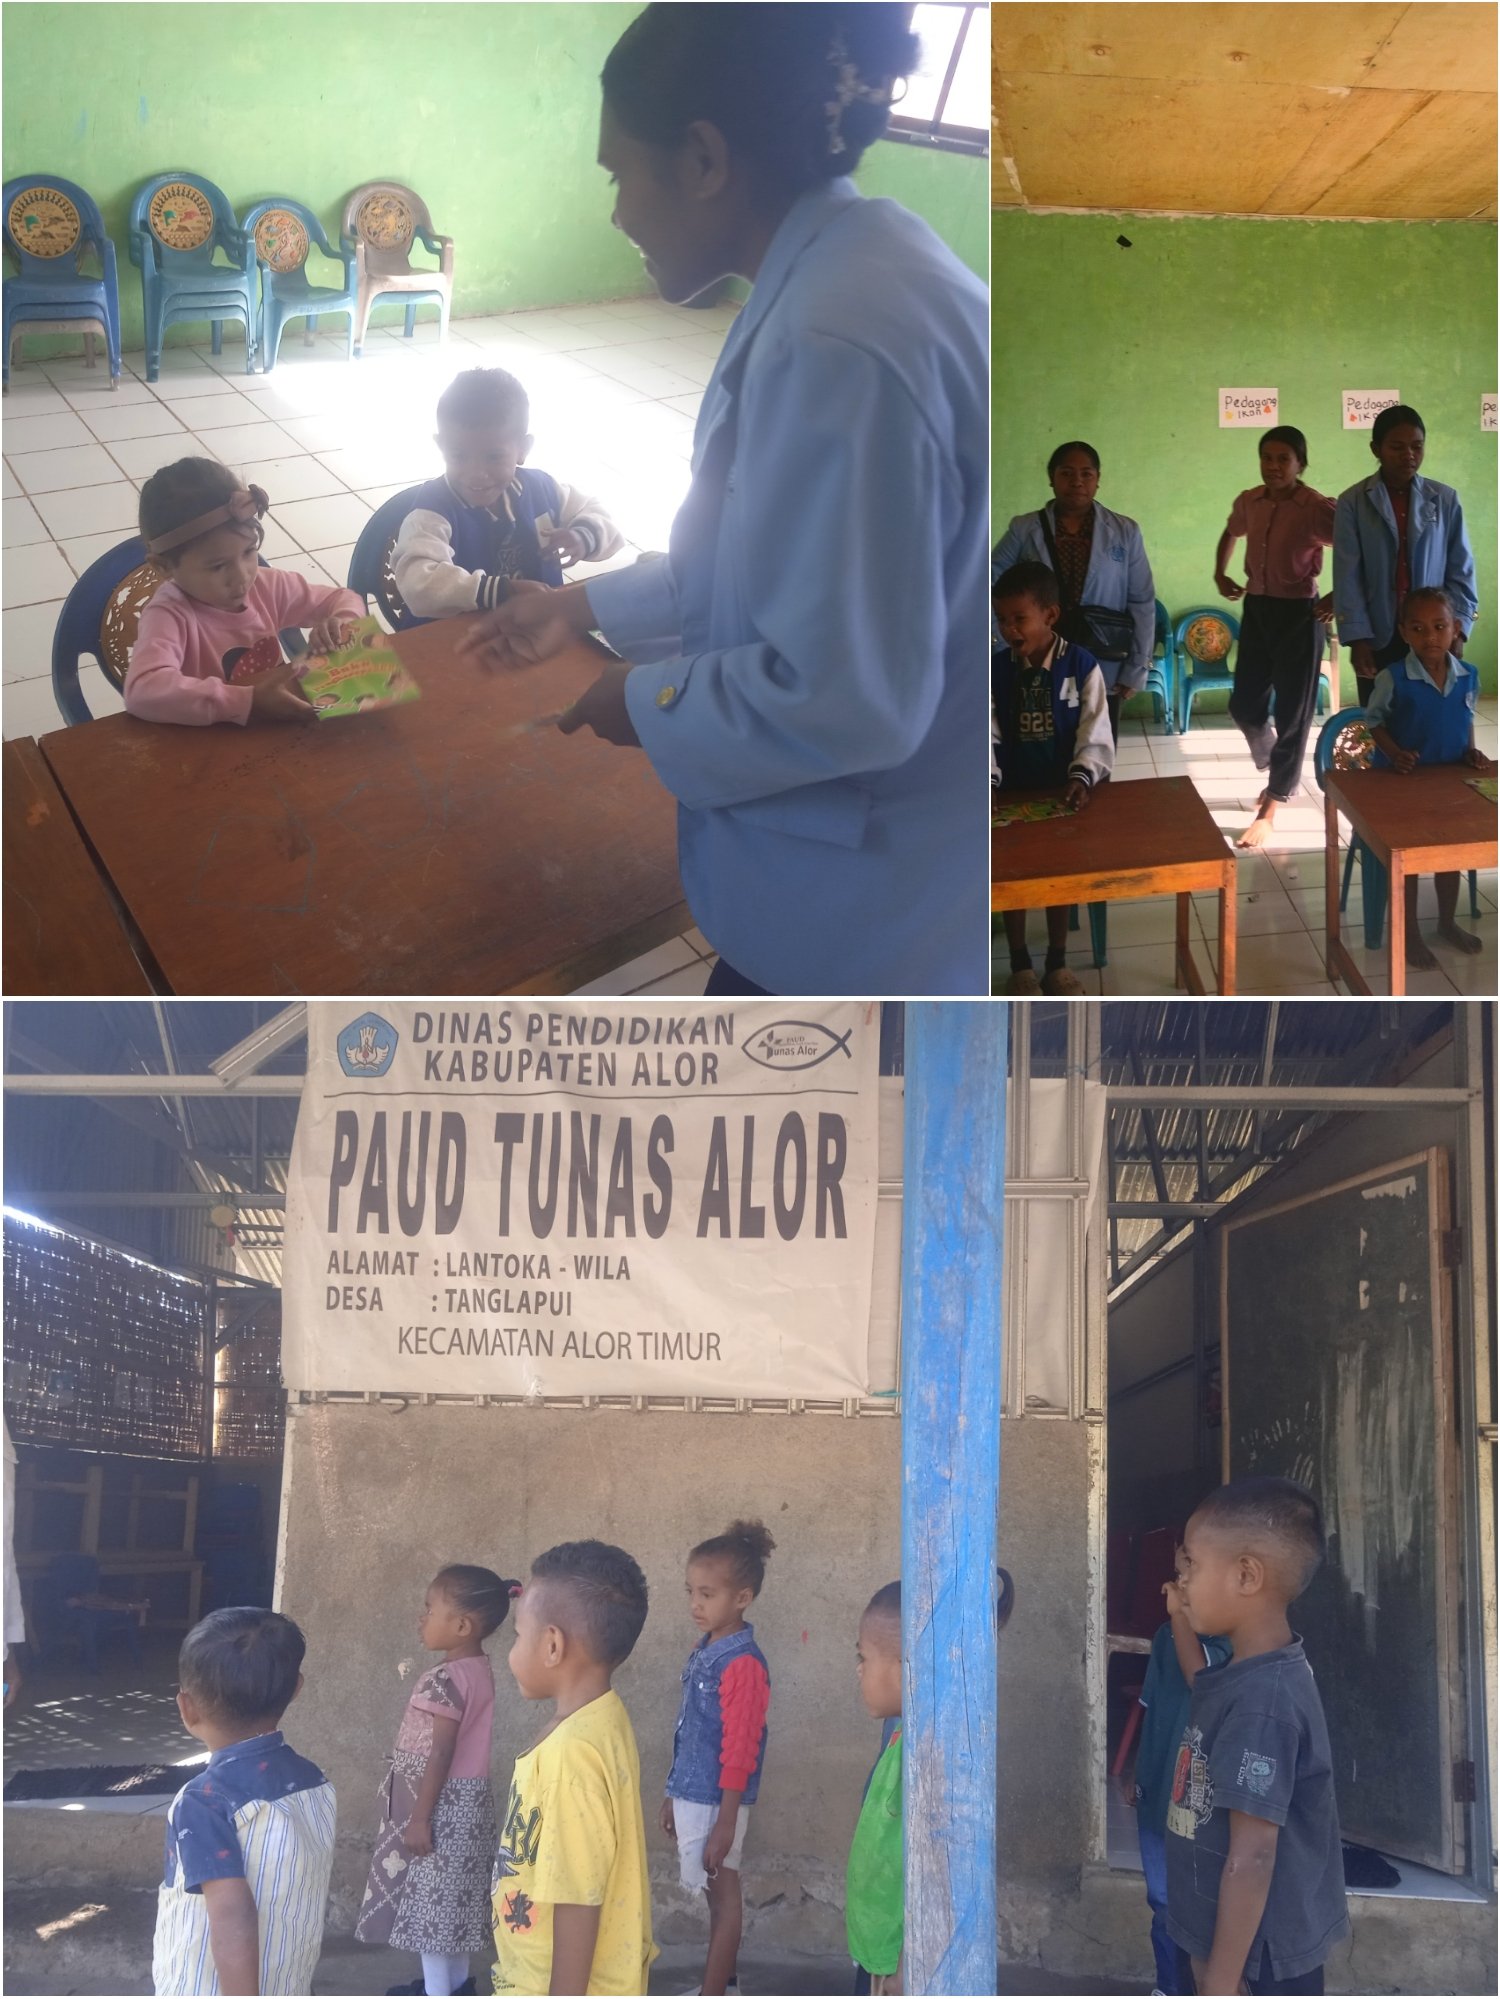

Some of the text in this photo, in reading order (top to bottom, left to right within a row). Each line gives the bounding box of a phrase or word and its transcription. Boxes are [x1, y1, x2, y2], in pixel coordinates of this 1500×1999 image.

[1059, 676, 1079, 708] 4
[413, 1011, 734, 1046] DINAS PENDIDIKAN
[786, 1036, 805, 1044] PAUD
[797, 1045, 818, 1056] Alor
[425, 1050, 718, 1086] KABUPATEN ALOR
[328, 1110, 847, 1241] PAUD TUNAS ALOR
[327, 1250, 419, 1276] ALAMAT
[446, 1252, 551, 1280] LANTOKA
[574, 1255, 631, 1280] WILA
[326, 1286, 384, 1312] DESA
[445, 1289, 571, 1316] TANGLAPUI
[398, 1327, 722, 1361] KECAMATAN ALOR TIMUR
